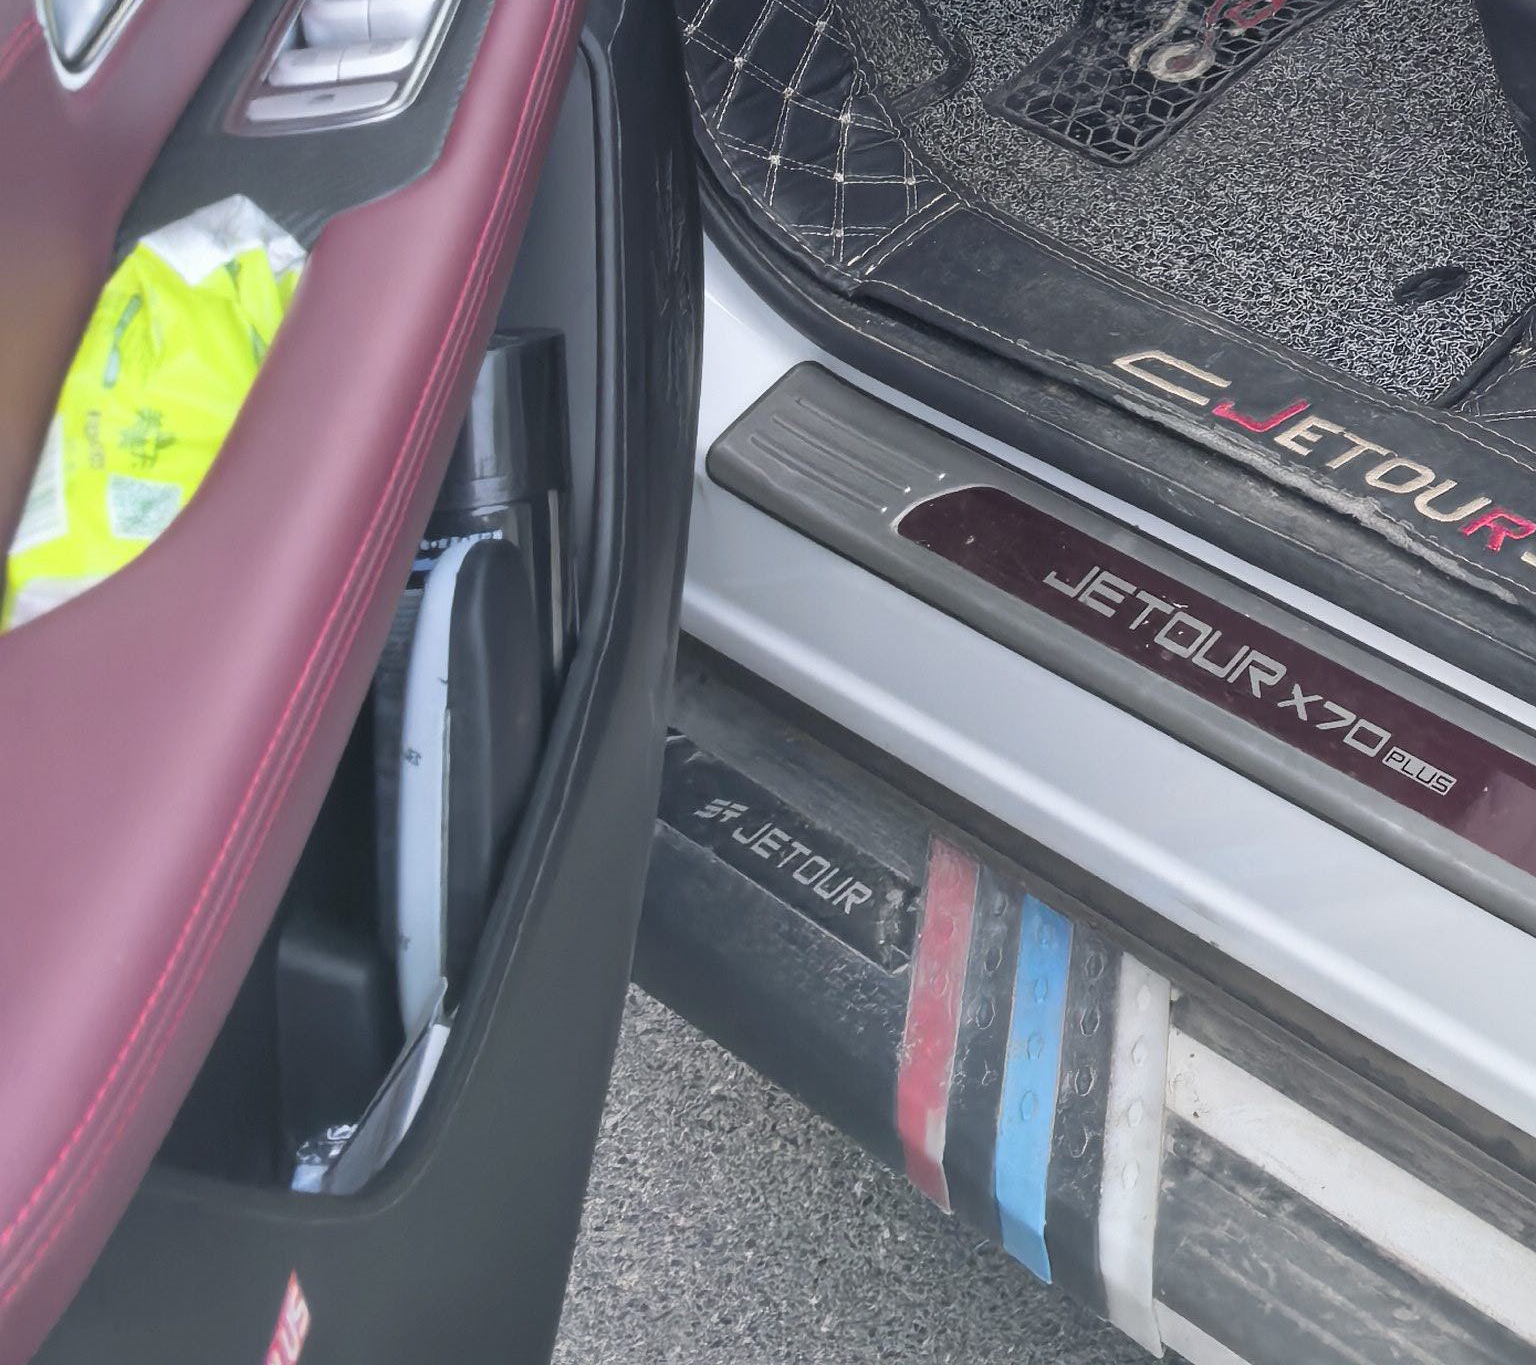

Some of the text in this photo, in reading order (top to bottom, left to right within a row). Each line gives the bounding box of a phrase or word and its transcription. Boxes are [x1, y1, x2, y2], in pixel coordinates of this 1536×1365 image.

[1042, 565, 1454, 795] JETOUR X70 PLUS
[731, 821, 874, 915] JETOUR
